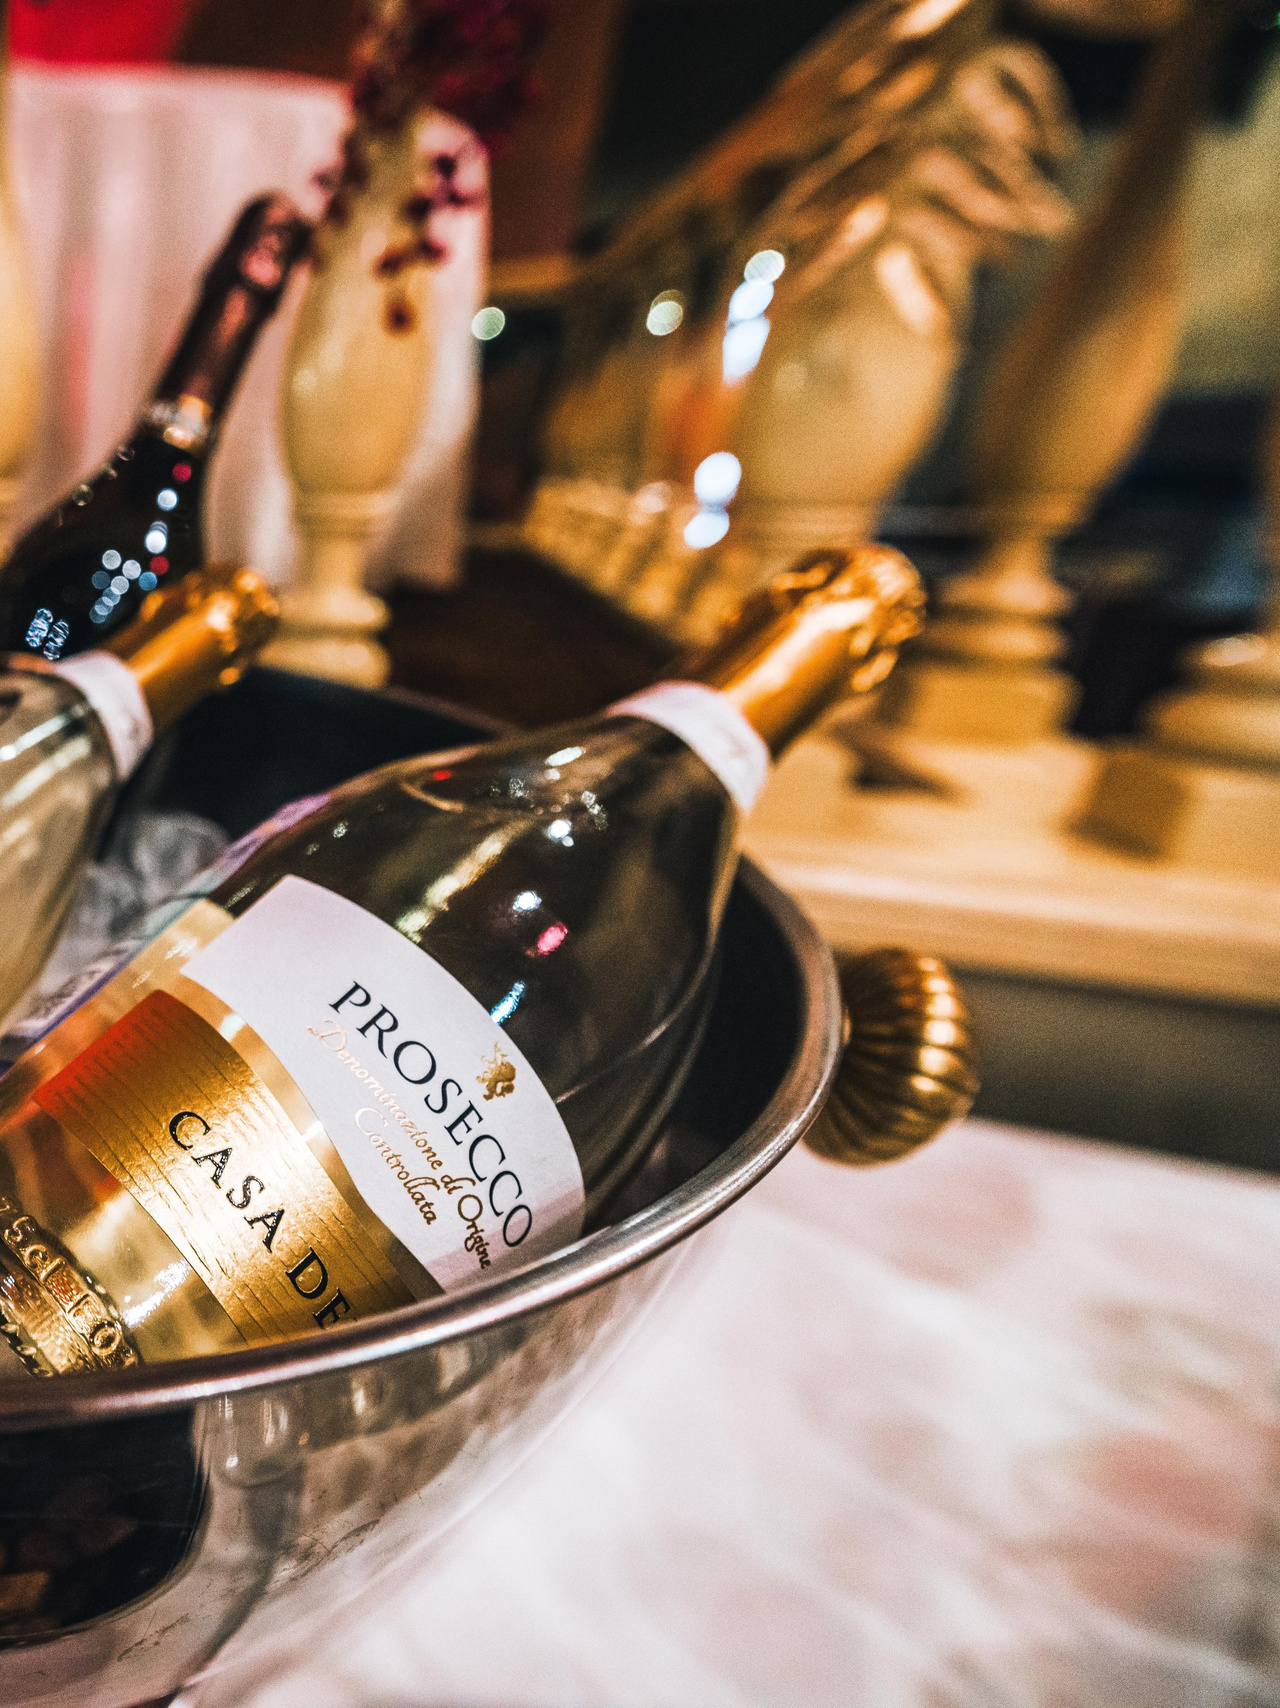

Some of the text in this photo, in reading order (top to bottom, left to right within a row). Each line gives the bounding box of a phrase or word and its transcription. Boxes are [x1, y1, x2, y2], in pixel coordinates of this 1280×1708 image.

[168, 1111, 285, 1253] CASA
[306, 1020, 492, 1270] Denominazione di Origine
[328, 980, 533, 1248] PROSECCO
[354, 1107, 441, 1226] Controllata
